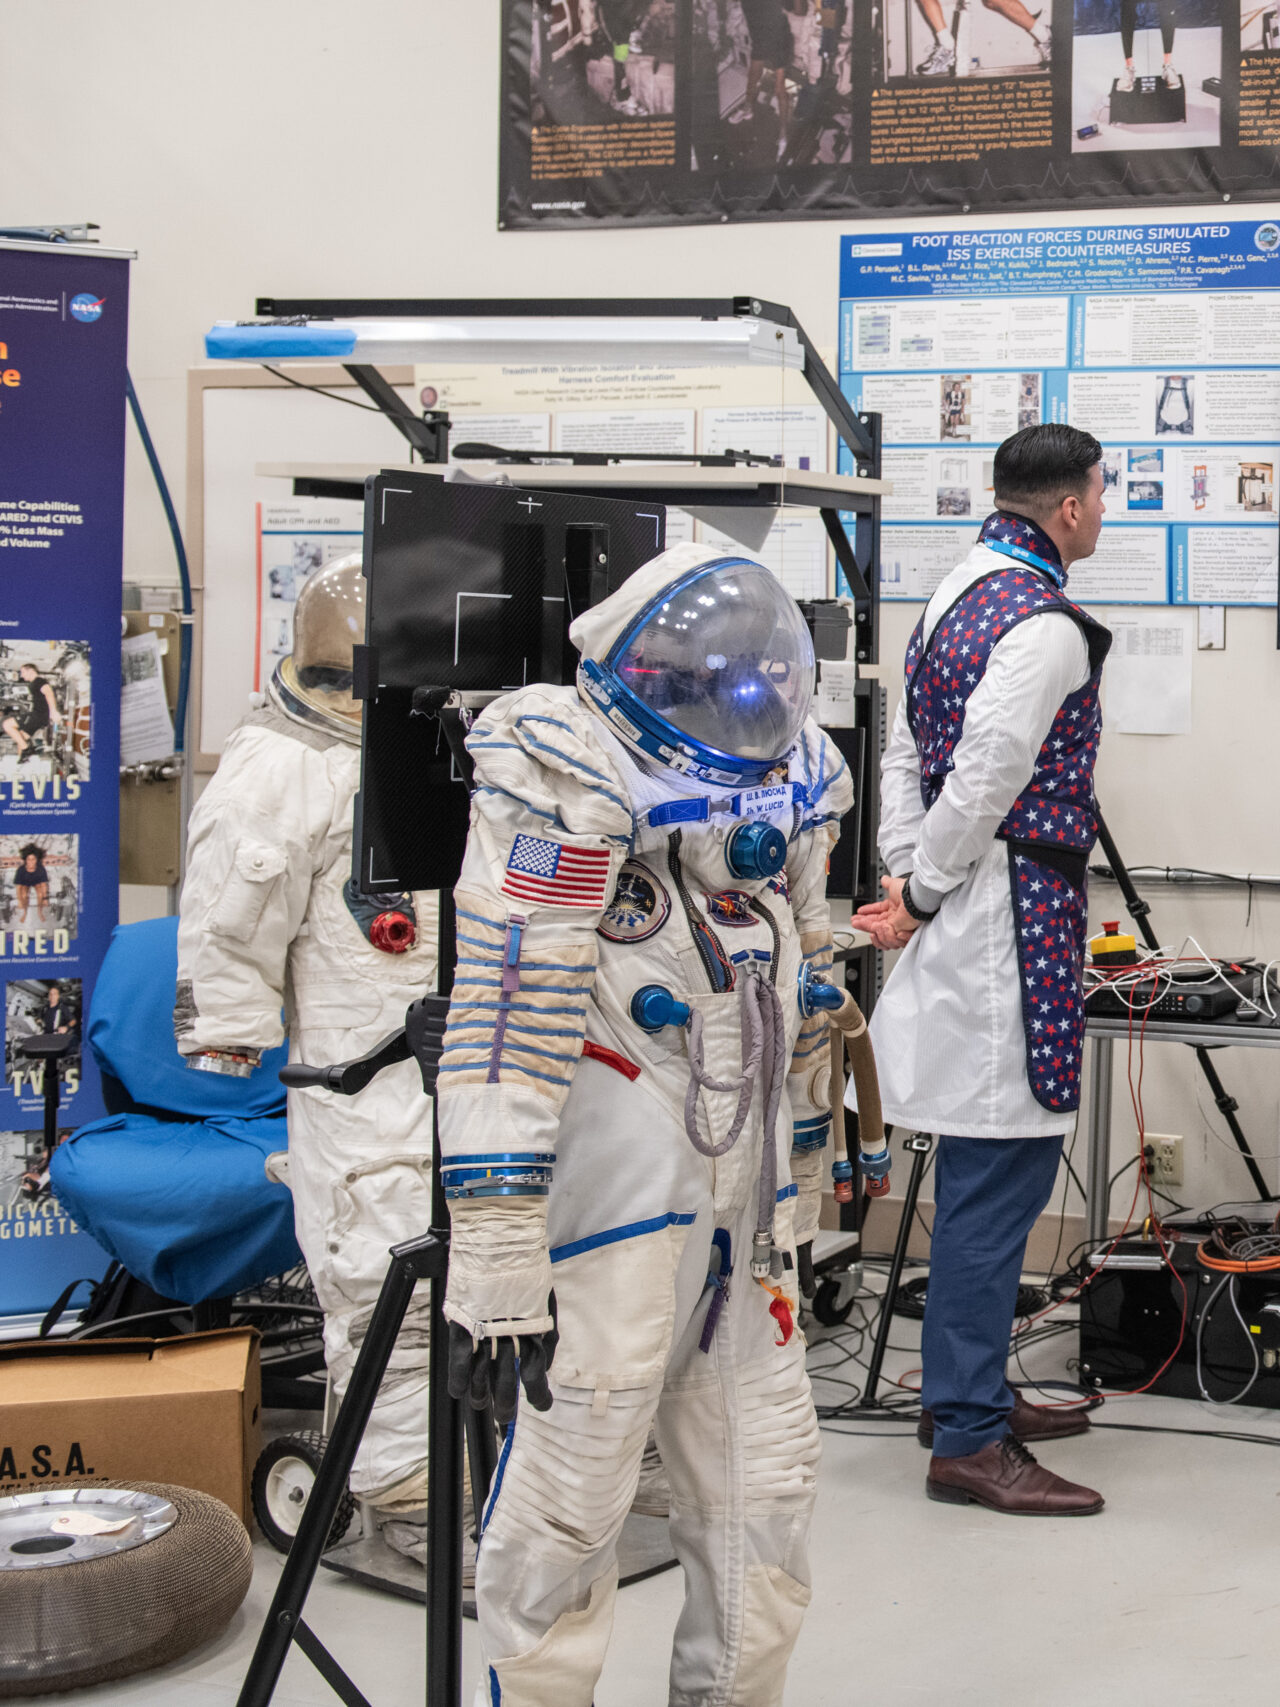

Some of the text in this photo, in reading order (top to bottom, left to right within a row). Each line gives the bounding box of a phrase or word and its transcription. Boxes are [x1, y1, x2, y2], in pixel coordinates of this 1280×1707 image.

[912, 226, 1230, 248] FOOT REACTION FORCES DURING SIMULATED
[947, 242, 1191, 261] ISS EXERCISE COUNTERMEASURES
[72, 304, 102, 312] NASA
[1074, 306, 1083, 356] Significance
[18, 501, 80, 512] Capabilities
[30, 514, 50, 523] and
[52, 515, 83, 524] CEVIS
[12, 526, 64, 536] Less Mass
[10, 538, 50, 548] Volume
[765, 801, 784, 811] LUCID
[12, 1068, 79, 1097] TVS
[0, 1218, 79, 1240] GOMETE
[0, 1443, 94, 1480] A.S.A.
